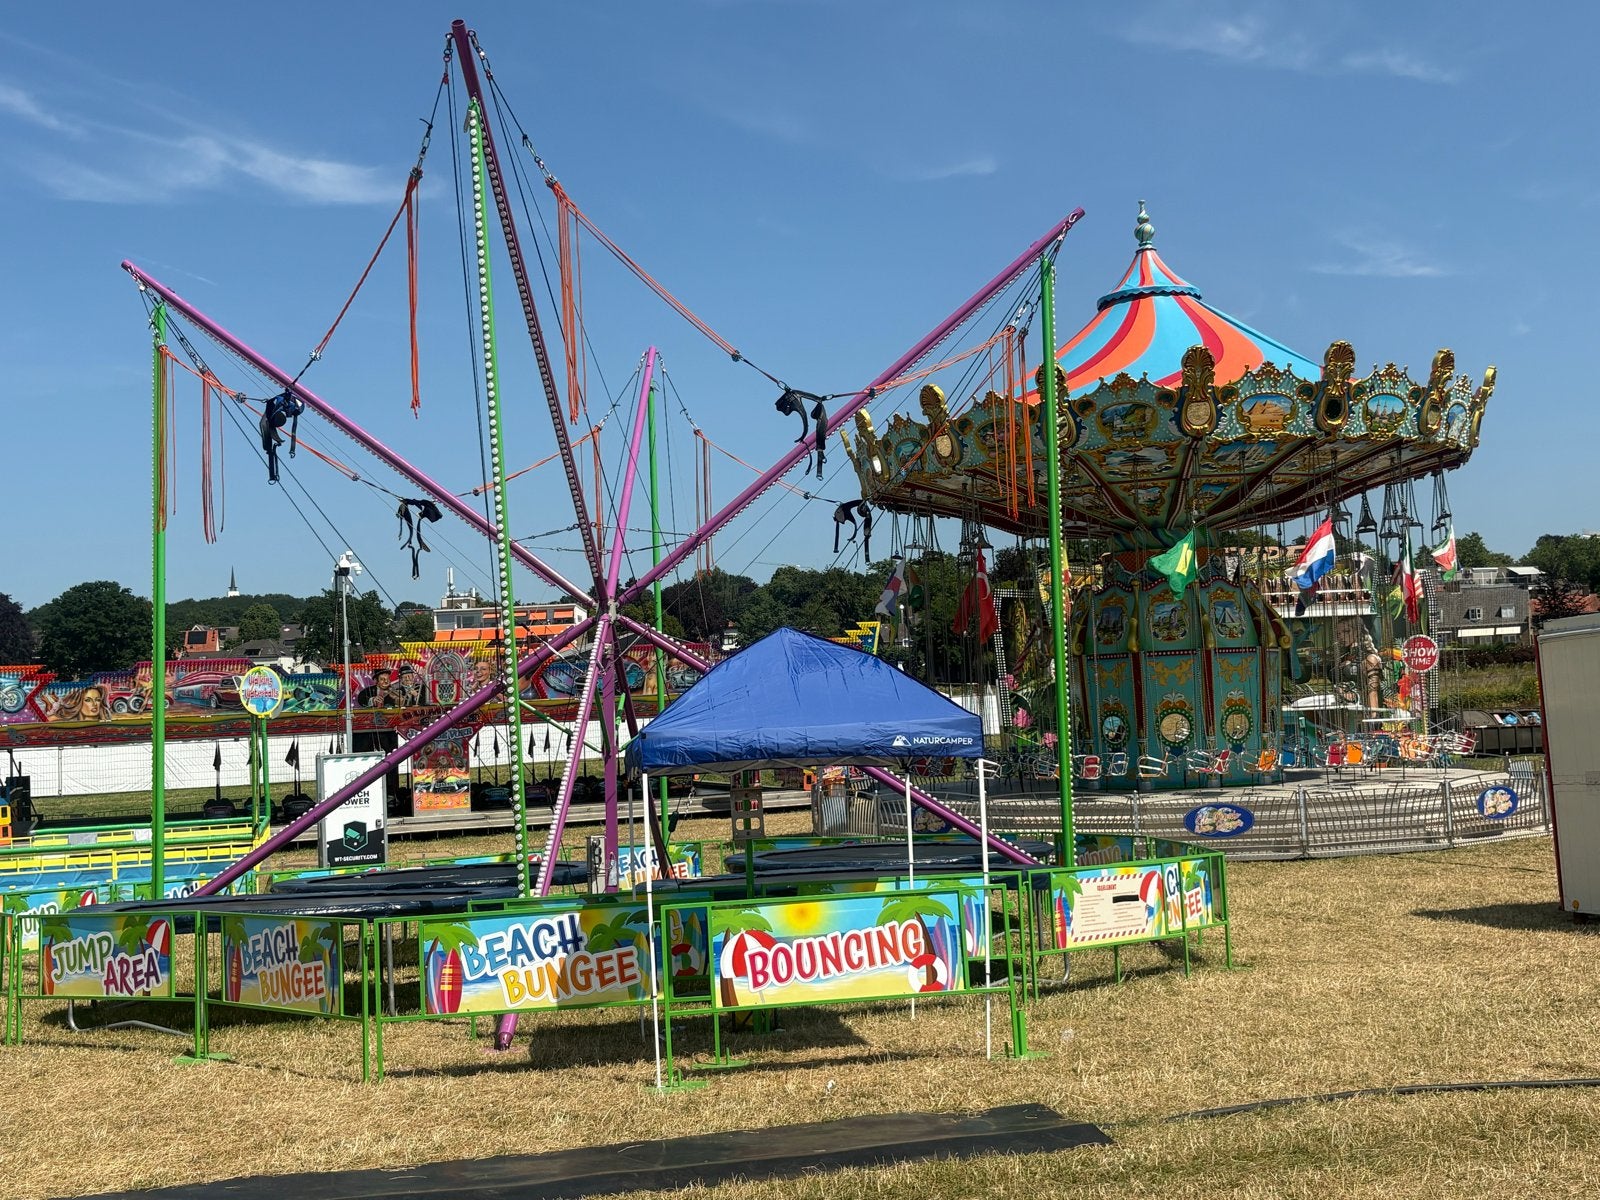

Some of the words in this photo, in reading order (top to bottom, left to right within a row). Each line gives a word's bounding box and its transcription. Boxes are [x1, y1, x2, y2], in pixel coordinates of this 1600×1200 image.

[1403, 647, 1437, 658] SHOW
[1411, 657, 1431, 666] TIME
[913, 736, 974, 745] NATURCAMPER
[342, 797, 370, 806] OWER
[334, 853, 378, 862] WT-SECURITY.COM
[618, 849, 660, 872] EACH
[53, 935, 111, 981] JUMP
[240, 924, 298, 973] BEACH
[461, 914, 584, 976] BEACH
[749, 923, 925, 989] BOUNCING
[104, 952, 161, 996] AREA
[259, 963, 324, 1004] BUNGEE
[502, 951, 638, 1004] BUNGEE
